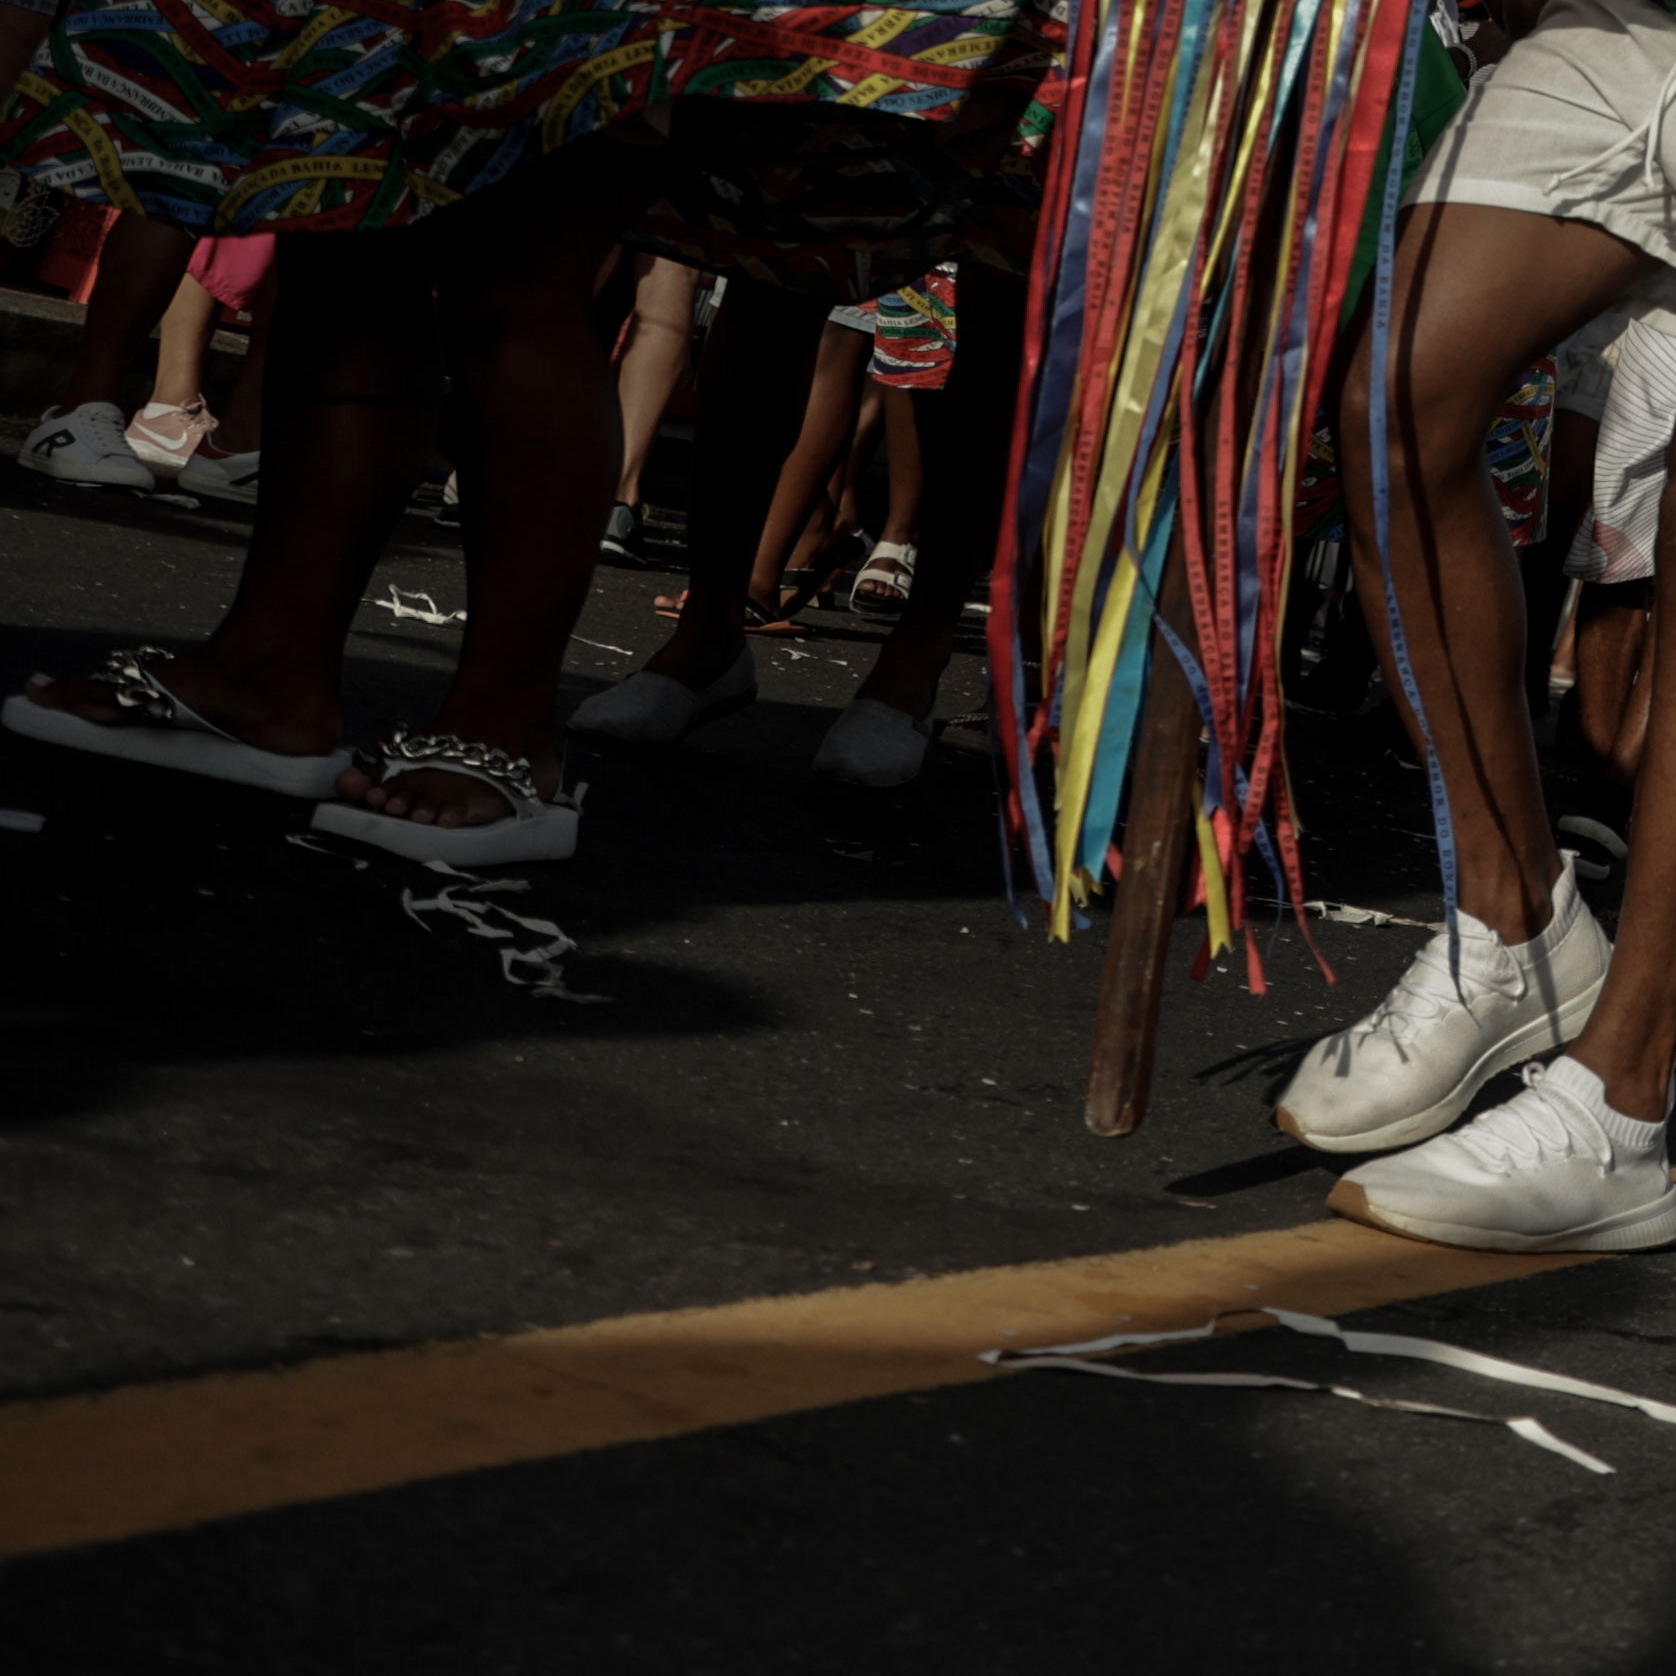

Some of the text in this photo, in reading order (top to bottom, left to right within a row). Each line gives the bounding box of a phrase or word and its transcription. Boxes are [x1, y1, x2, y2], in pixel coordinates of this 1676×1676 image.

[1408, 26, 1421, 49] DO
[93, 69, 113, 86] DA
[882, 94, 905, 111] DO
[56, 167, 77, 183] DA
[157, 156, 206, 180] BAHIA
[268, 160, 342, 182] DA BAHIA
[1380, 244, 1391, 266] DA
[1375, 275, 1389, 330] BAHIA
[1214, 501, 1233, 641] LEMBRANÇA DO
[1437, 817, 1458, 917] DO BONFIM
